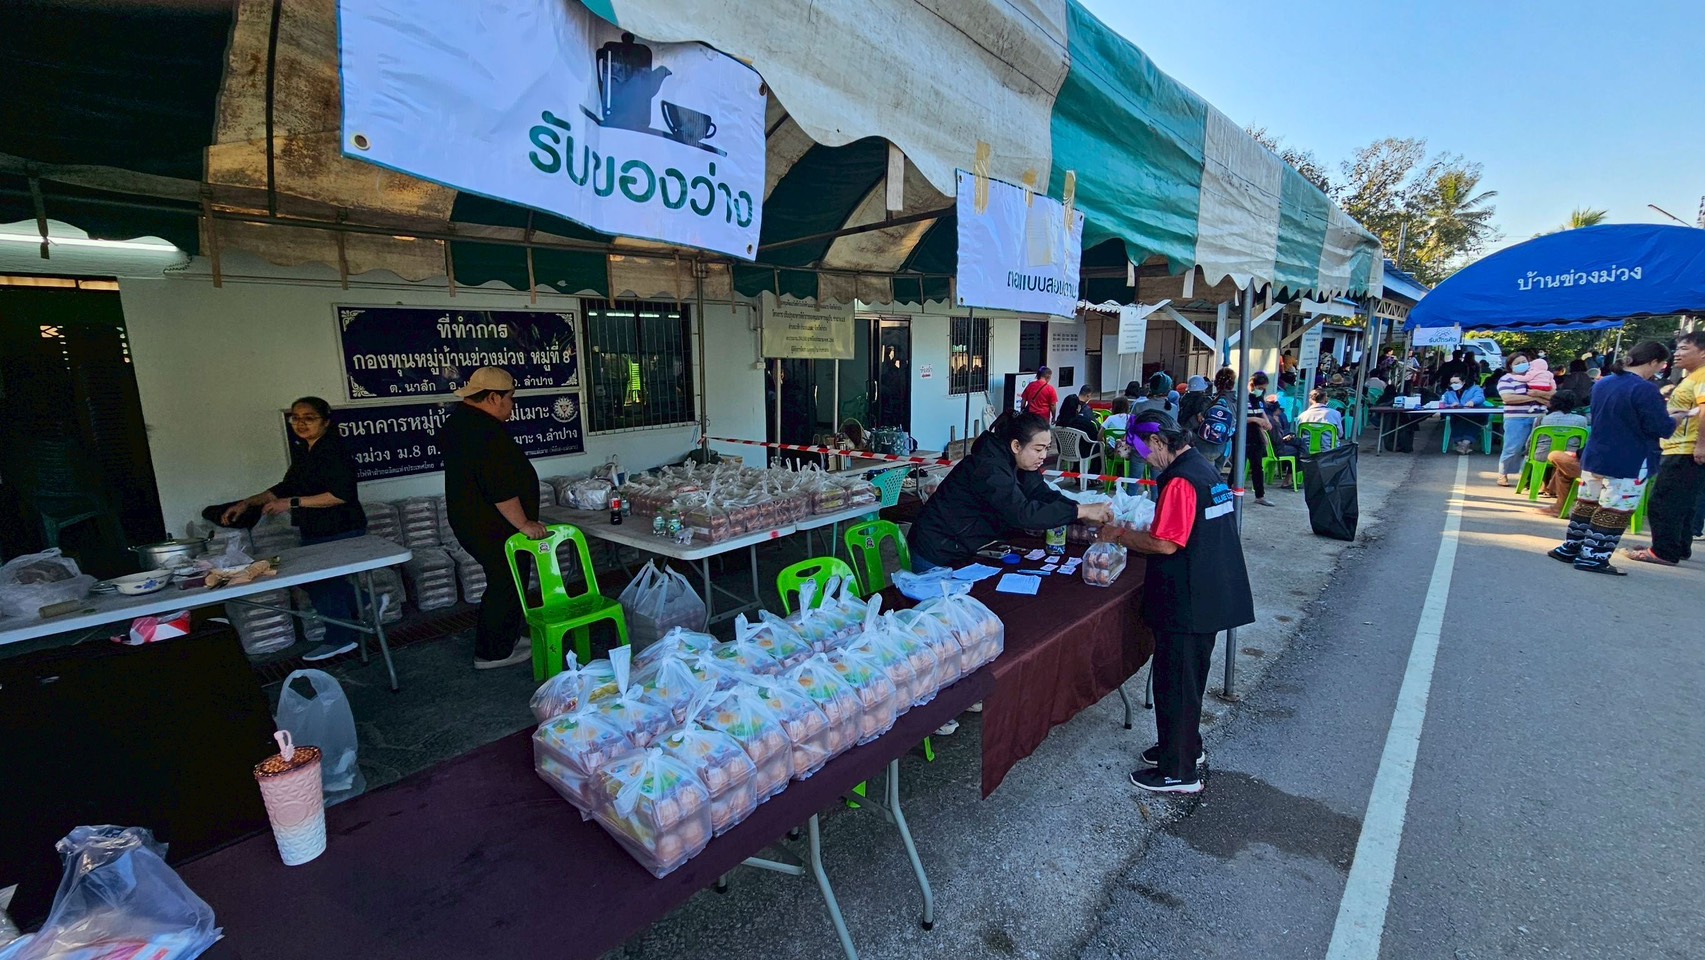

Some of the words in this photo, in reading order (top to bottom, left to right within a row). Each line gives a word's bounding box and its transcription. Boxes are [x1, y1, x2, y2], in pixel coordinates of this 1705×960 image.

[529, 110, 754, 228] รับของว่าง
[1517, 264, 1642, 291] บ้านข่วงม่วง
[436, 313, 508, 339] ที่ทำการ
[352, 345, 526, 377] กองทุนหมู่บ้านข่วงม่วง
[530, 341, 560, 372] หมู่ที่
[562, 350, 571, 364] 8
[389, 383, 402, 394] ต.
[405, 378, 436, 392] นาสัก
[448, 381, 461, 391] อ.
[524, 375, 554, 388] ลำปาง
[504, 402, 550, 422] ม่เมาะ
[351, 446, 391, 464] งม่วง
[396, 444, 422, 460] ม.8
[427, 444, 441, 456] ต.
[535, 427, 578, 443] จ.ลำปาง
